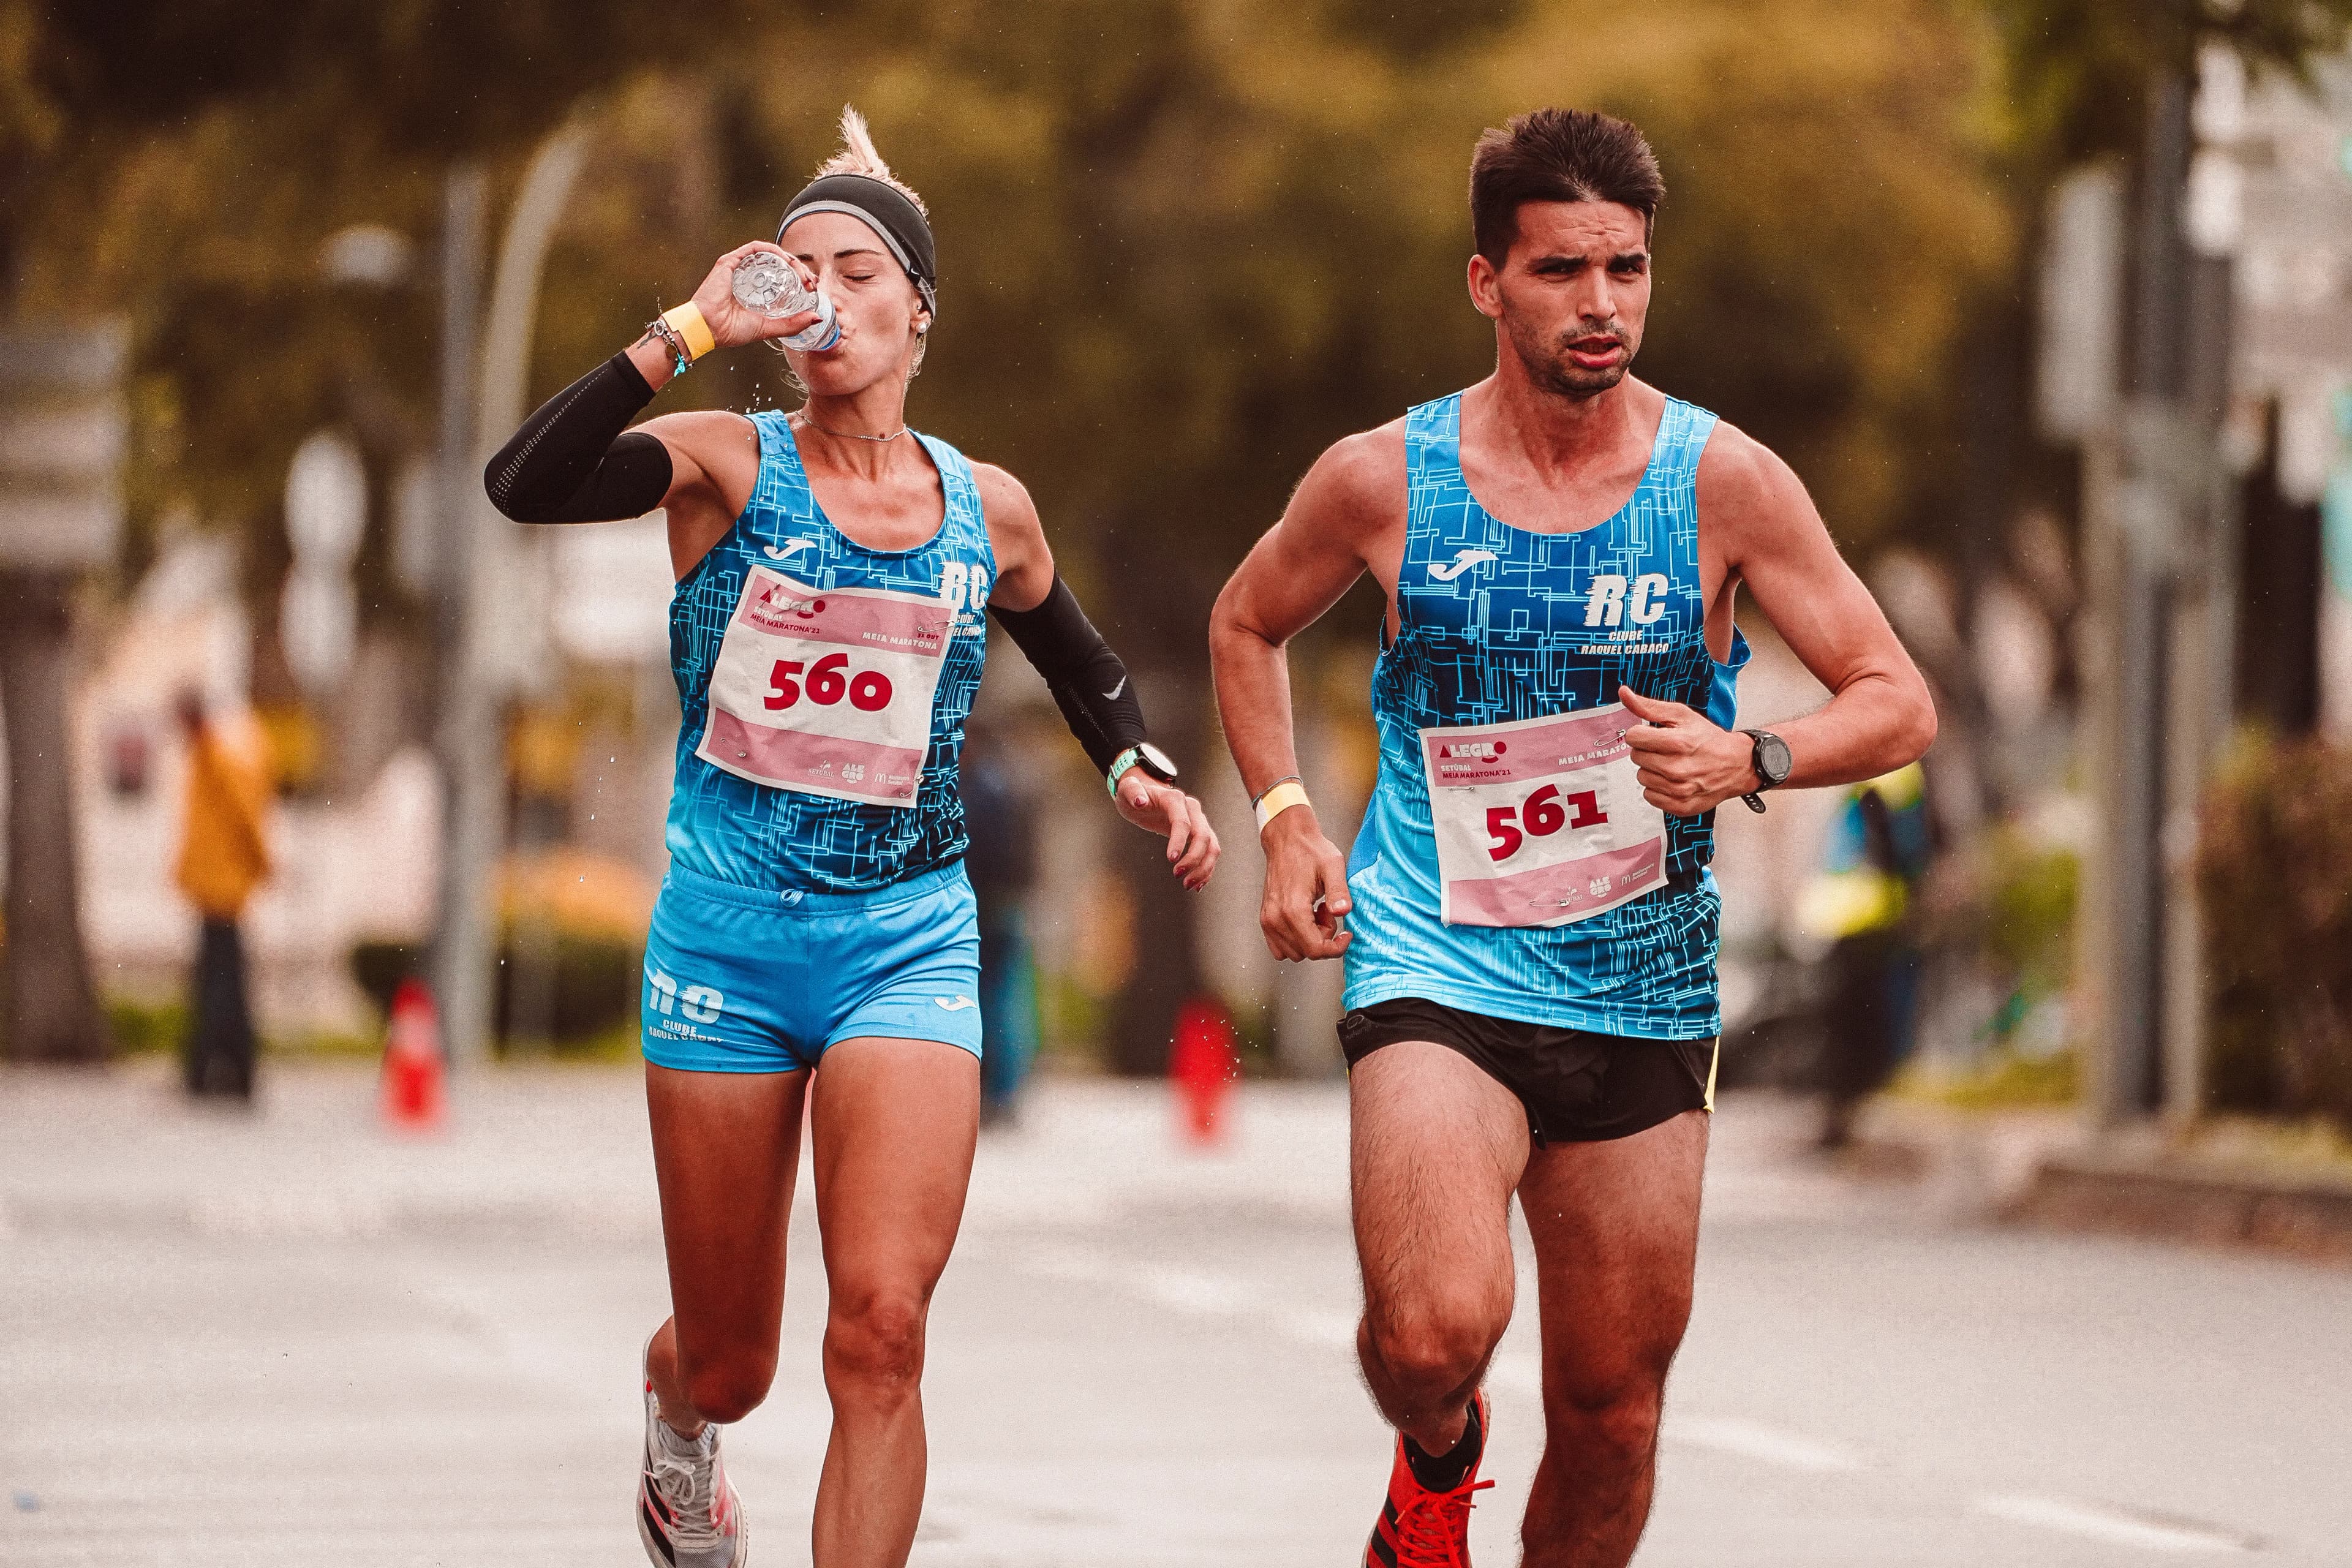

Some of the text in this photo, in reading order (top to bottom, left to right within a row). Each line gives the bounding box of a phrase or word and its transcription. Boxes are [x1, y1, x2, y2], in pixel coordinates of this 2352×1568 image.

[938, 561, 988, 609] RC
[1583, 573, 1668, 627] RC
[750, 613, 765, 625] MEIA
[862, 631, 937, 650] MEIA MARATONA
[1608, 630, 1643, 641] CLUBE
[1581, 645, 1623, 655] RAQUEL
[763, 653, 892, 712] 560
[1439, 741, 1507, 758] ALEGRO
[1558, 742, 1630, 766] MEIA MARATO
[1486, 783, 1608, 862] 561
[662, 1019, 697, 1035] CLUBE
